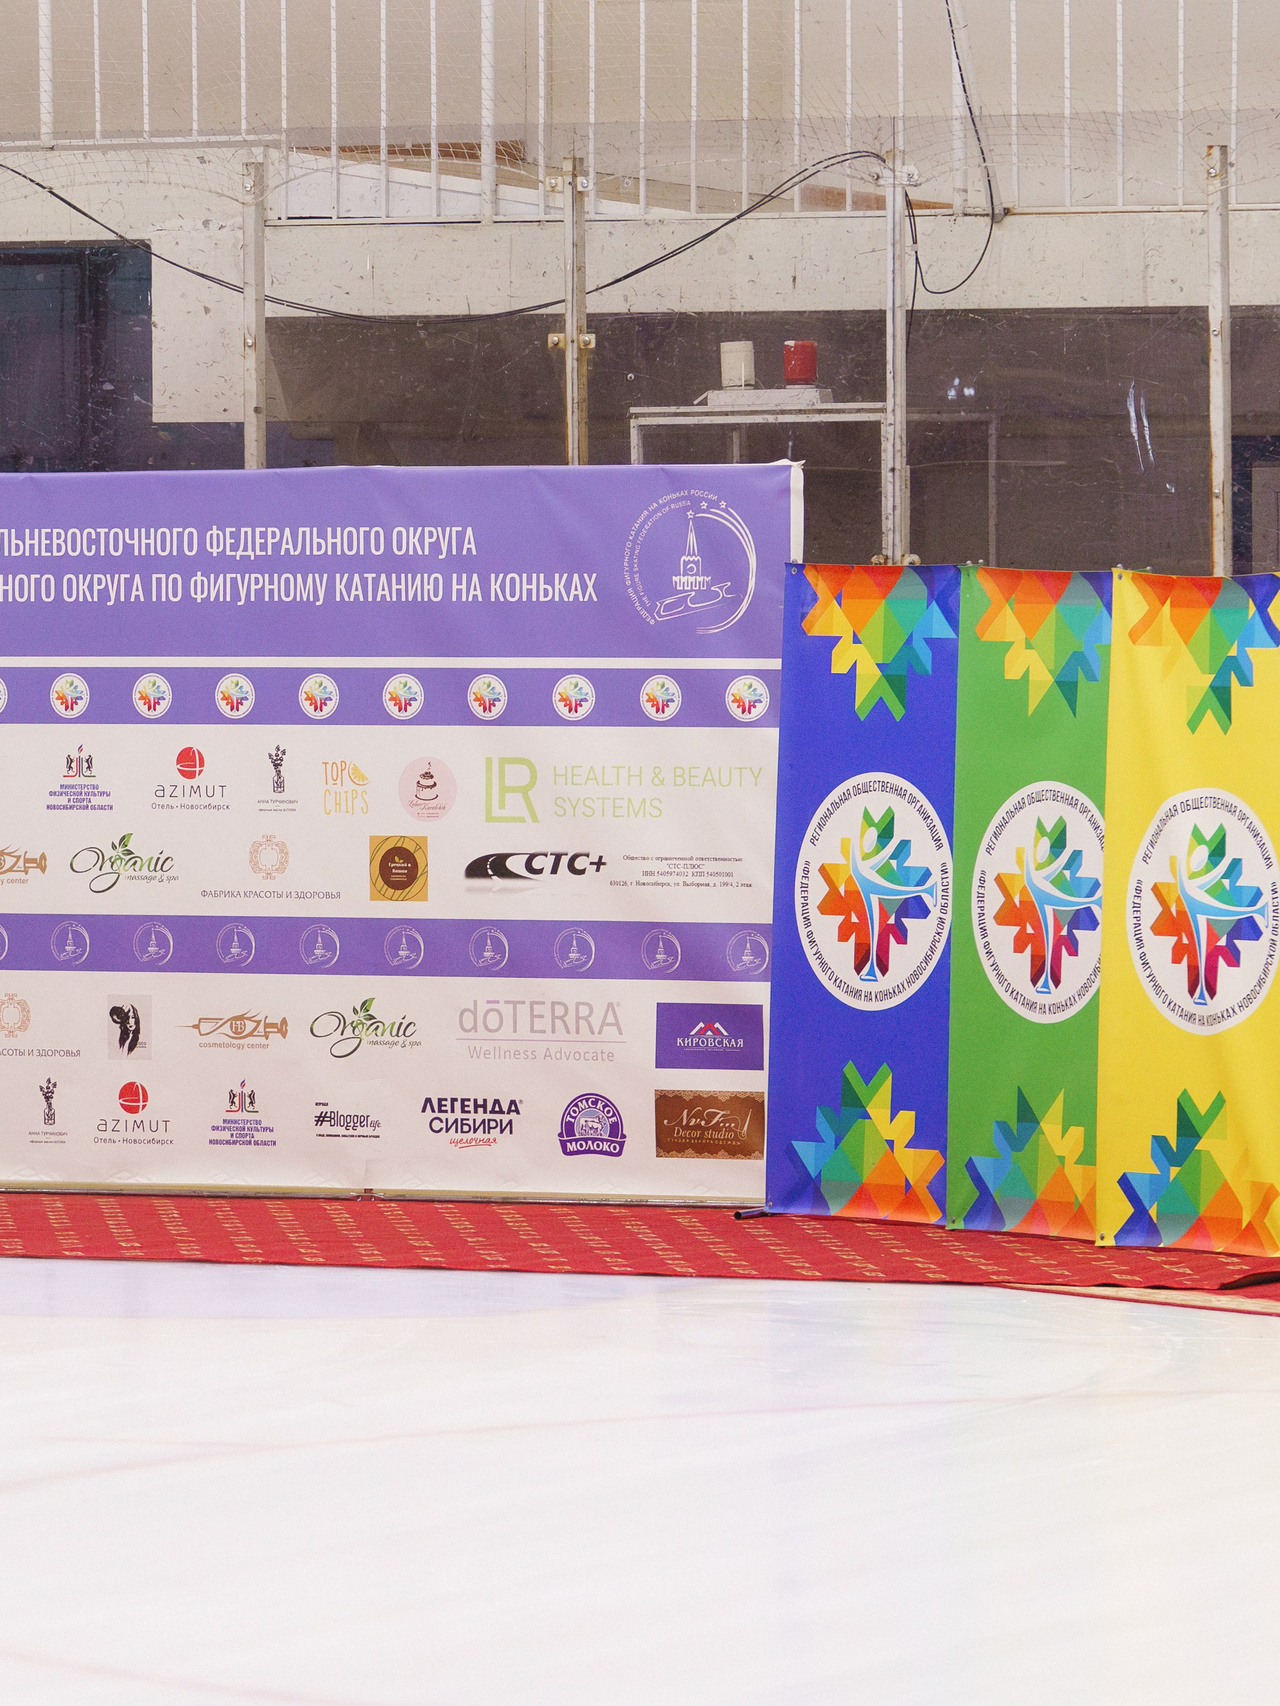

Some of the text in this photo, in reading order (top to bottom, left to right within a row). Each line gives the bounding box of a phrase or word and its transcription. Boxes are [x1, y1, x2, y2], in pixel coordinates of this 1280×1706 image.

[206, 525, 384, 560] ФЕДЕРАЛЬНОГО
[392, 526, 477, 559] ОКРУГА
[623, 490, 718, 625] ФЕДЕРАЦИЯ ФИГУРНОГО КАТАНИЯ НА КОНЬКАХ РОССИИ
[62, 573, 145, 606] ОКРУГА
[151, 573, 182, 602] ПО
[189, 571, 328, 606] ФИГУРНОМУ
[336, 573, 443, 602] КАТАНИЮ
[451, 573, 483, 602] НА
[490, 573, 598, 602] КОНЬКАХ
[322, 760, 347, 787] TOP
[553, 765, 763, 788] HEALTH & BEAUTY
[485, 757, 540, 823] LR
[180, 803, 230, 811] Новосибирск
[323, 789, 369, 816] CHIPS
[554, 796, 663, 818] SYSTEMS
[810, 780, 944, 851] РЕГИОНАЛЬНАЯ ОБЩЕСТВЕННАЯ ОРГАНИЗАЦИЯ
[985, 789, 1079, 856] РЕГИОНАЛЬНАЯ ОБЩЕСТВЕННАЯ
[1142, 795, 1273, 870] РЕГИОНАЛЬНАЯ ОБЩЕСТВЕННАЯ ОРГАНИЗАЦИЯ
[6, 877, 29, 885] center
[70, 847, 174, 893] Organic
[125, 874, 179, 884] massage & spa
[201, 889, 241, 898] ФАБРИКА
[244, 890, 284, 898] КРАСОТЫ
[294, 891, 341, 900] ЗДОРОВЬЯ
[806, 928, 836, 982] ФИГУРНОГО
[834, 975, 863, 1003] КАТАНИЯ
[864, 990, 873, 1003] НА
[875, 980, 908, 1003] КОНЬКАХ
[906, 917, 947, 988] НОВОСИБИРСКОЙ
[983, 940, 1012, 993] ФИГУРНОГО
[1009, 987, 1038, 1015] КАТАНИЯ
[1038, 1002, 1047, 1015] НА
[1048, 992, 1077, 1016] КОНЬКАХ
[1138, 936, 1278, 1027] ФИГУРНОГО КАТАНИЯ НА КОНЬКАХ НОВОСИБИРСКОЙ
[458, 1000, 623, 1036] dōTERRA
[199, 1041, 245, 1050] cosmetology
[310, 1011, 417, 1058] Organic
[367, 1039, 422, 1049] massage & spa
[677, 1038, 744, 1047] КИРОВСКАЯ
[28, 1048, 34, 1056] И
[36, 1049, 81, 1058] ЗДОРОВЬЯ
[467, 1046, 615, 1062] Wellness Advocate
[421, 1097, 521, 1115] ЛЕГЕНДА
[566, 1098, 618, 1124] ТОМСКОЕ
[222, 1118, 262, 1126] МИНИСТЕРСТВО
[314, 1111, 370, 1131] #Blogger
[429, 1116, 513, 1135] СИБИРИ
[122, 1138, 174, 1146] Новосибирск
[450, 1136, 498, 1145] щелочная
[674, 1127, 734, 1140] Decor studio
[566, 1140, 620, 1154] МОЛОКО
